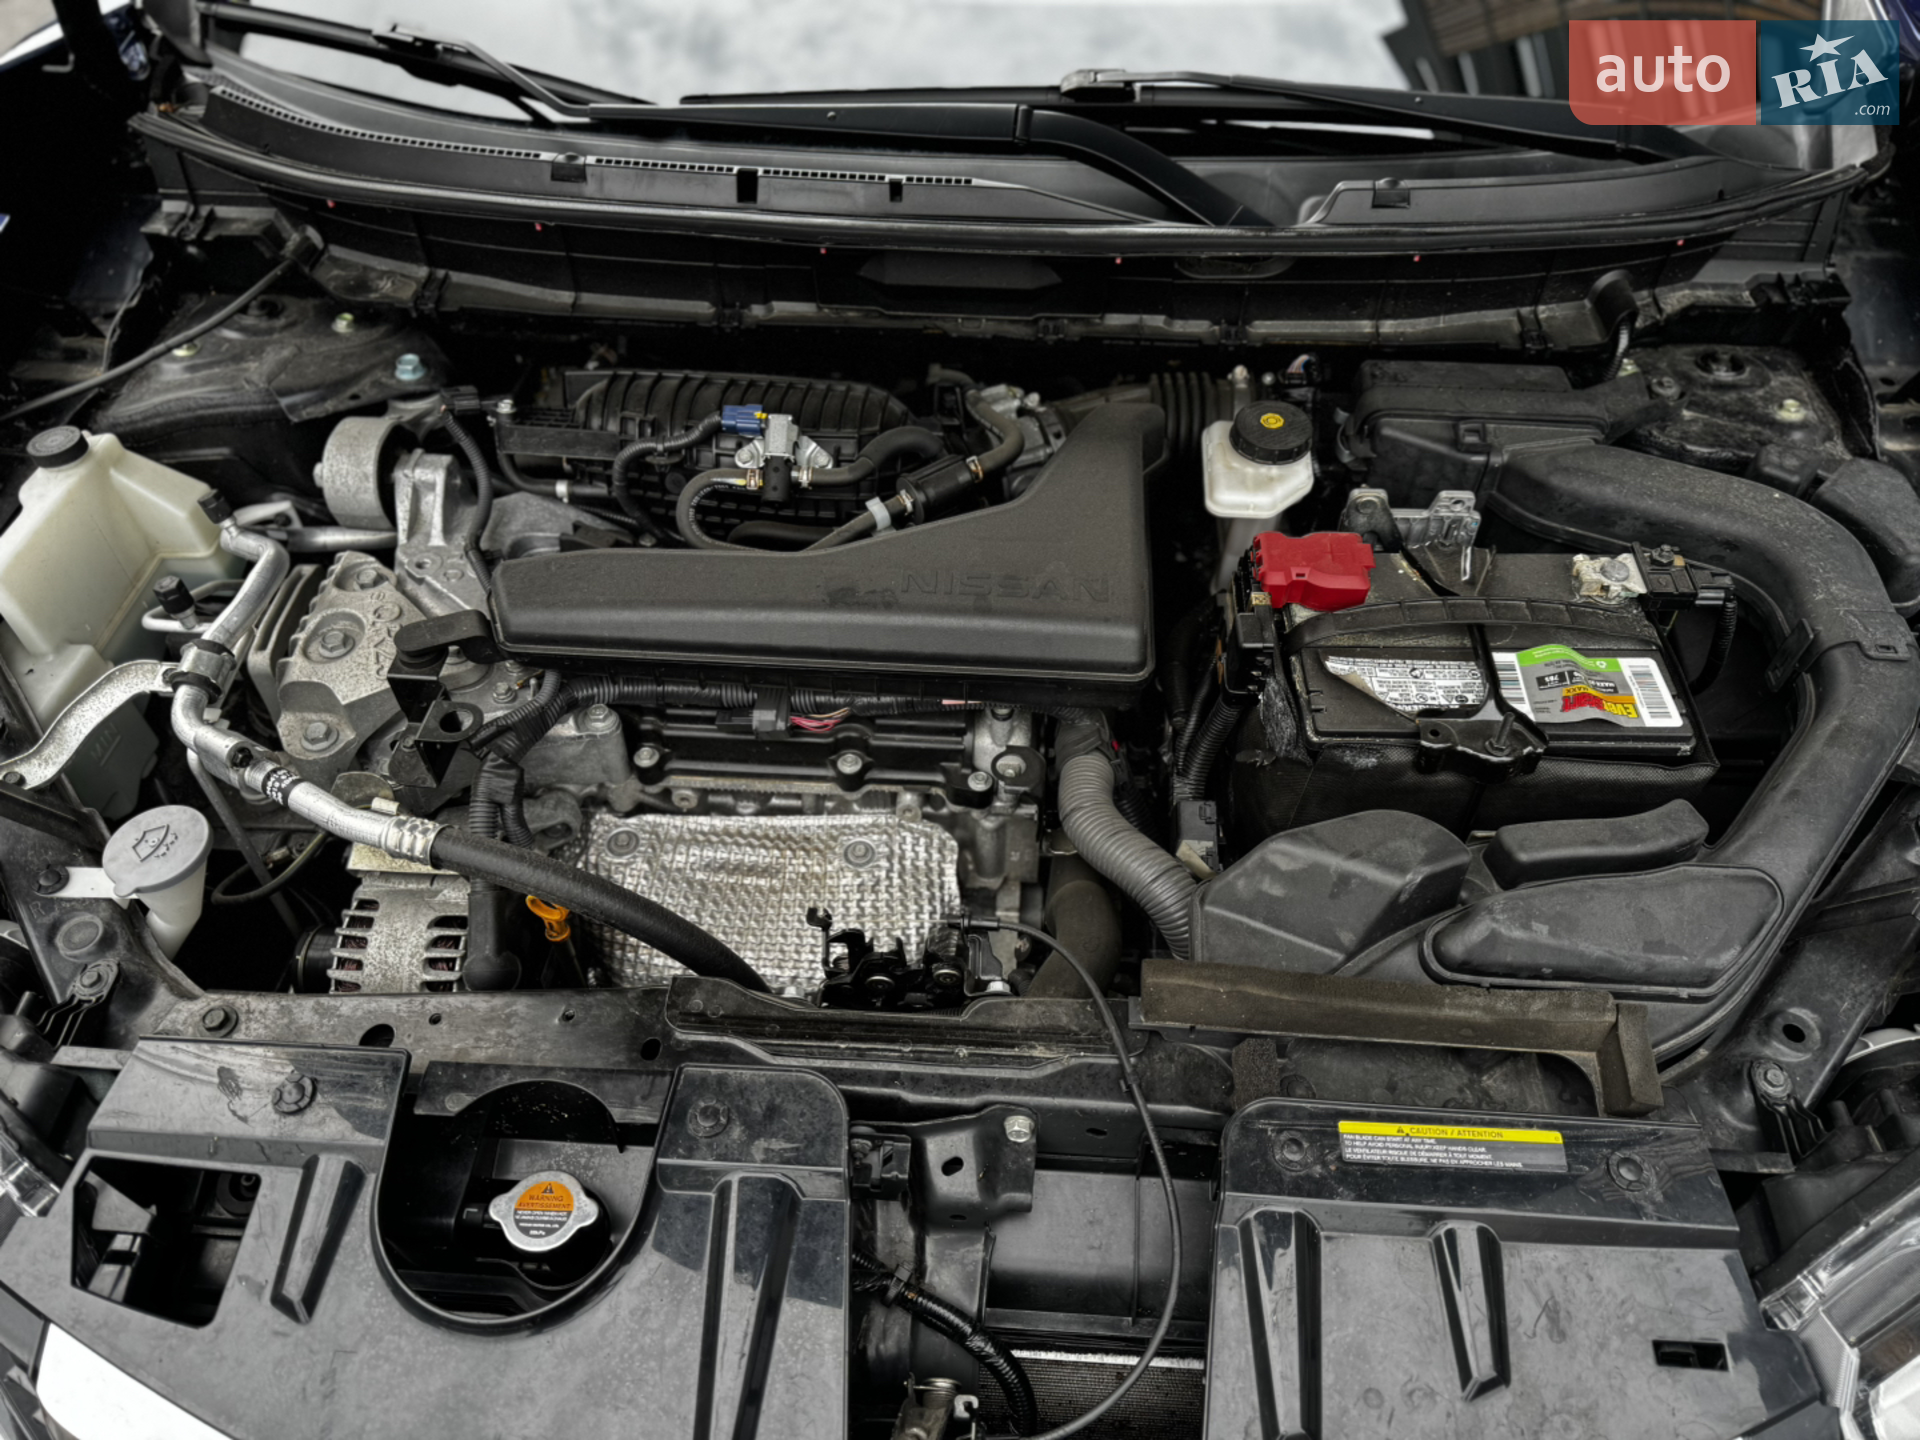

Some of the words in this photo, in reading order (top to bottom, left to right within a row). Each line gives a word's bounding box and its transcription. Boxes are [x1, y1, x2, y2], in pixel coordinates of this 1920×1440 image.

[900, 570, 1110, 603] NISSAN
[1410, 1127, 1448, 1136] CAUTION
[1457, 1130, 1504, 1139] ATTENTION
